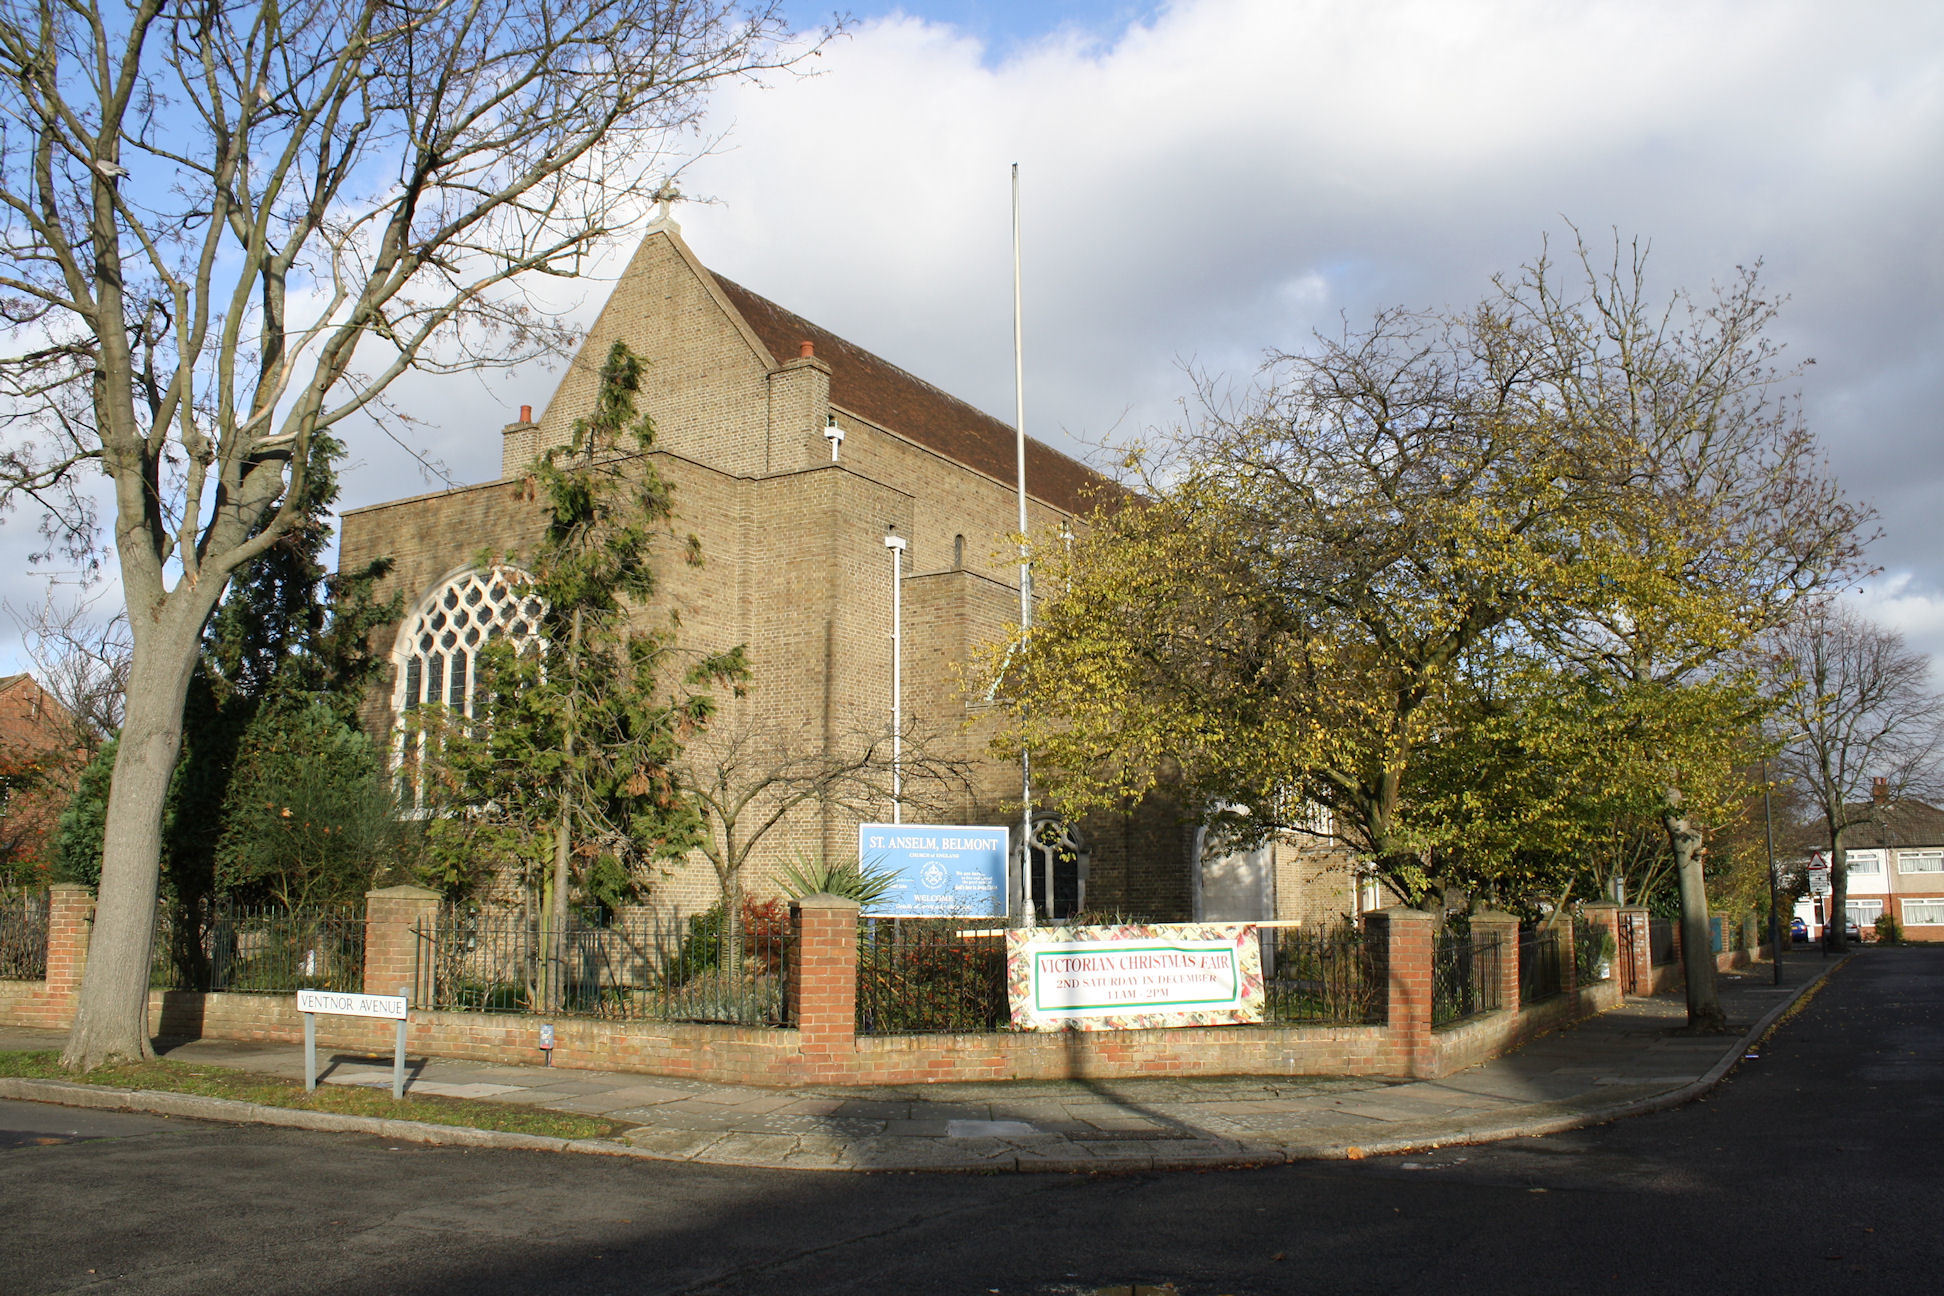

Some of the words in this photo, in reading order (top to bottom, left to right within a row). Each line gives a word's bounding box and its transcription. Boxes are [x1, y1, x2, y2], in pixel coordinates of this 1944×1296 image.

[869, 836, 886, 848] ST.
[888, 837, 940, 851] ANSELM,
[942, 838, 999, 851] BELMONT
[913, 894, 955, 902] WELCOME
[1041, 957, 1116, 973] VICTORIAN
[1120, 955, 1196, 971] CHRISTMAS
[1201, 955, 1230, 969] FAIR
[1056, 978, 1080, 989] 2ND
[1083, 975, 1138, 987] SATURDAY
[1143, 975, 1154, 984] IN
[1158, 973, 1217, 984] DECEMBER
[1108, 989, 1136, 999] 11AM
[1146, 988, 1169, 998] 2PM
[301, 994, 353, 1010] VENTNOR
[360, 999, 402, 1014] AVENUE
